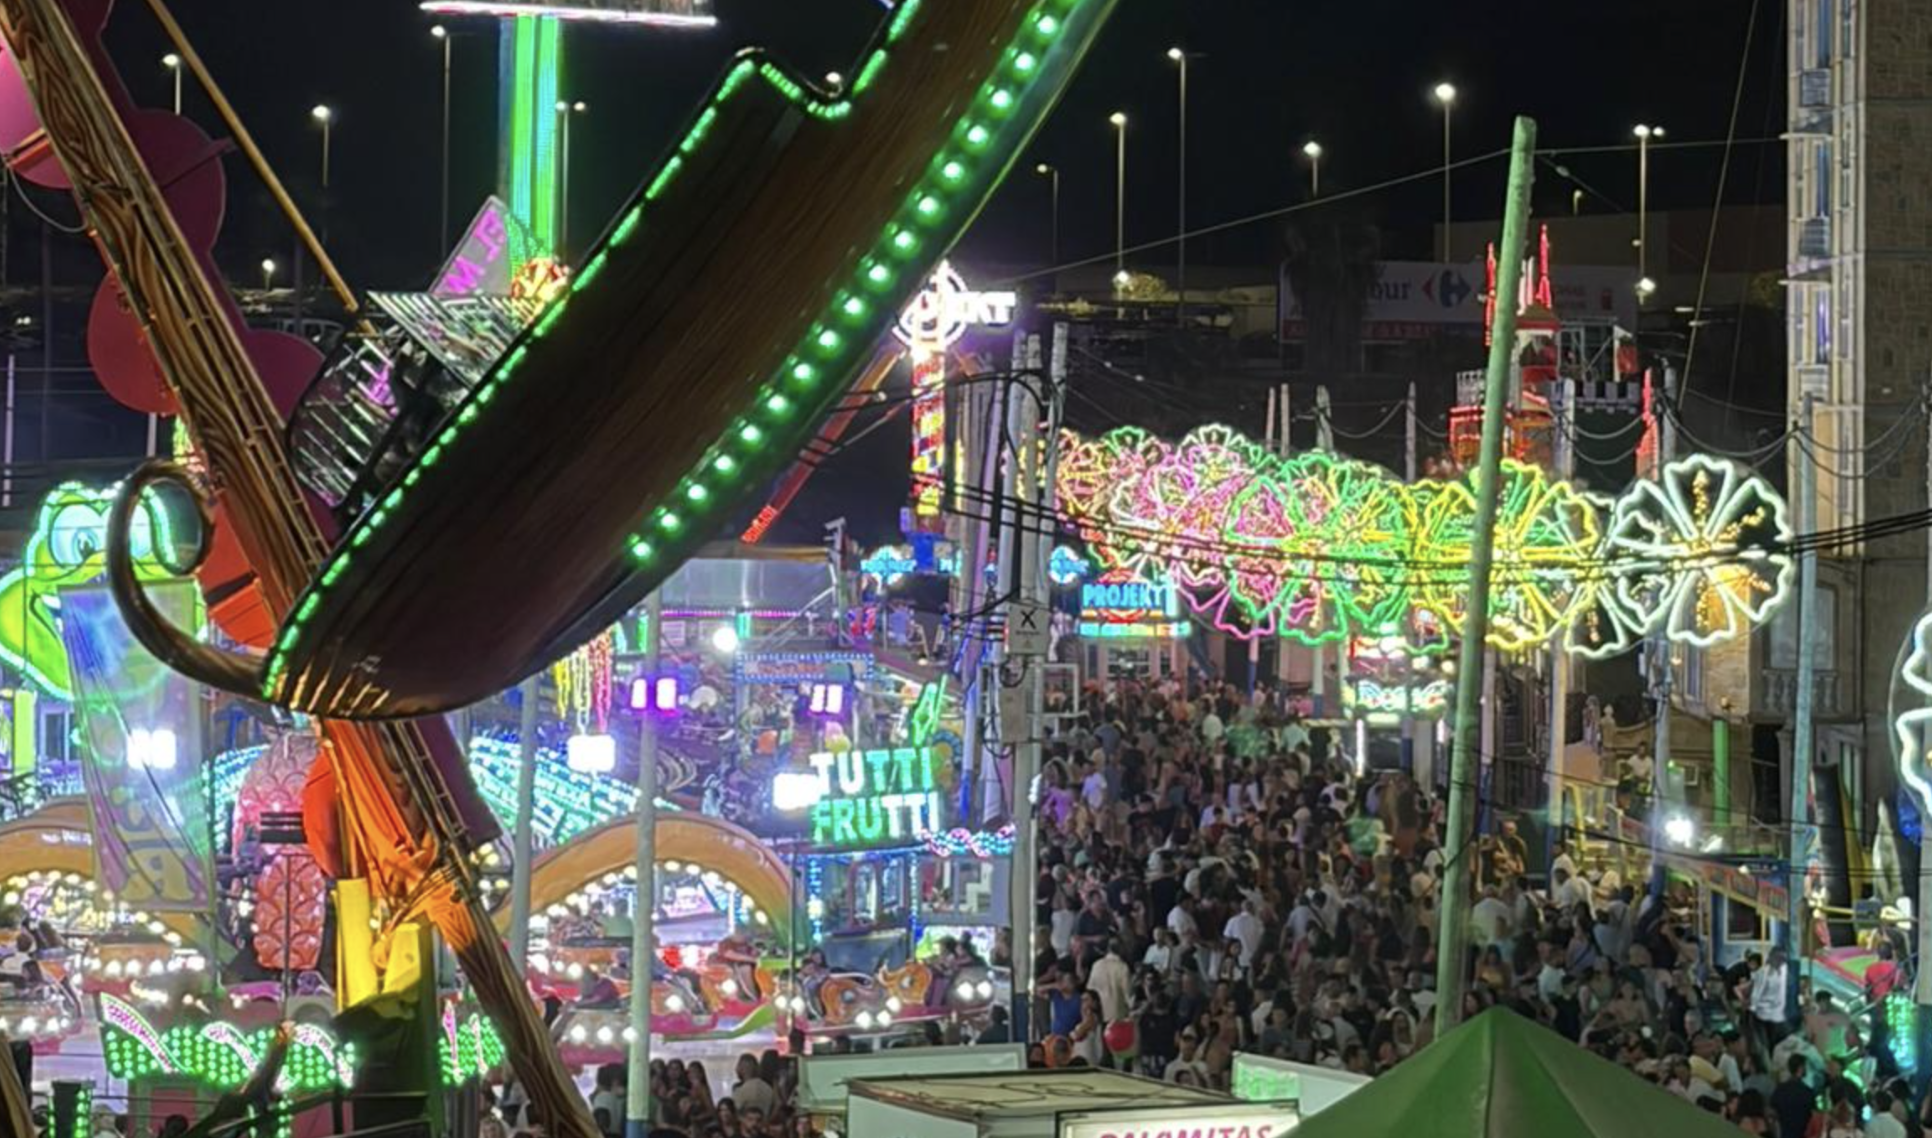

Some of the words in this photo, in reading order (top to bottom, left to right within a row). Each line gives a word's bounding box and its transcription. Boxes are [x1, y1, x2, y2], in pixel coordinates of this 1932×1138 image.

[809, 747, 933, 796] TUTTI
[813, 791, 940, 843] FRUTTI
[1100, 1125, 1272, 1138] MITAS
